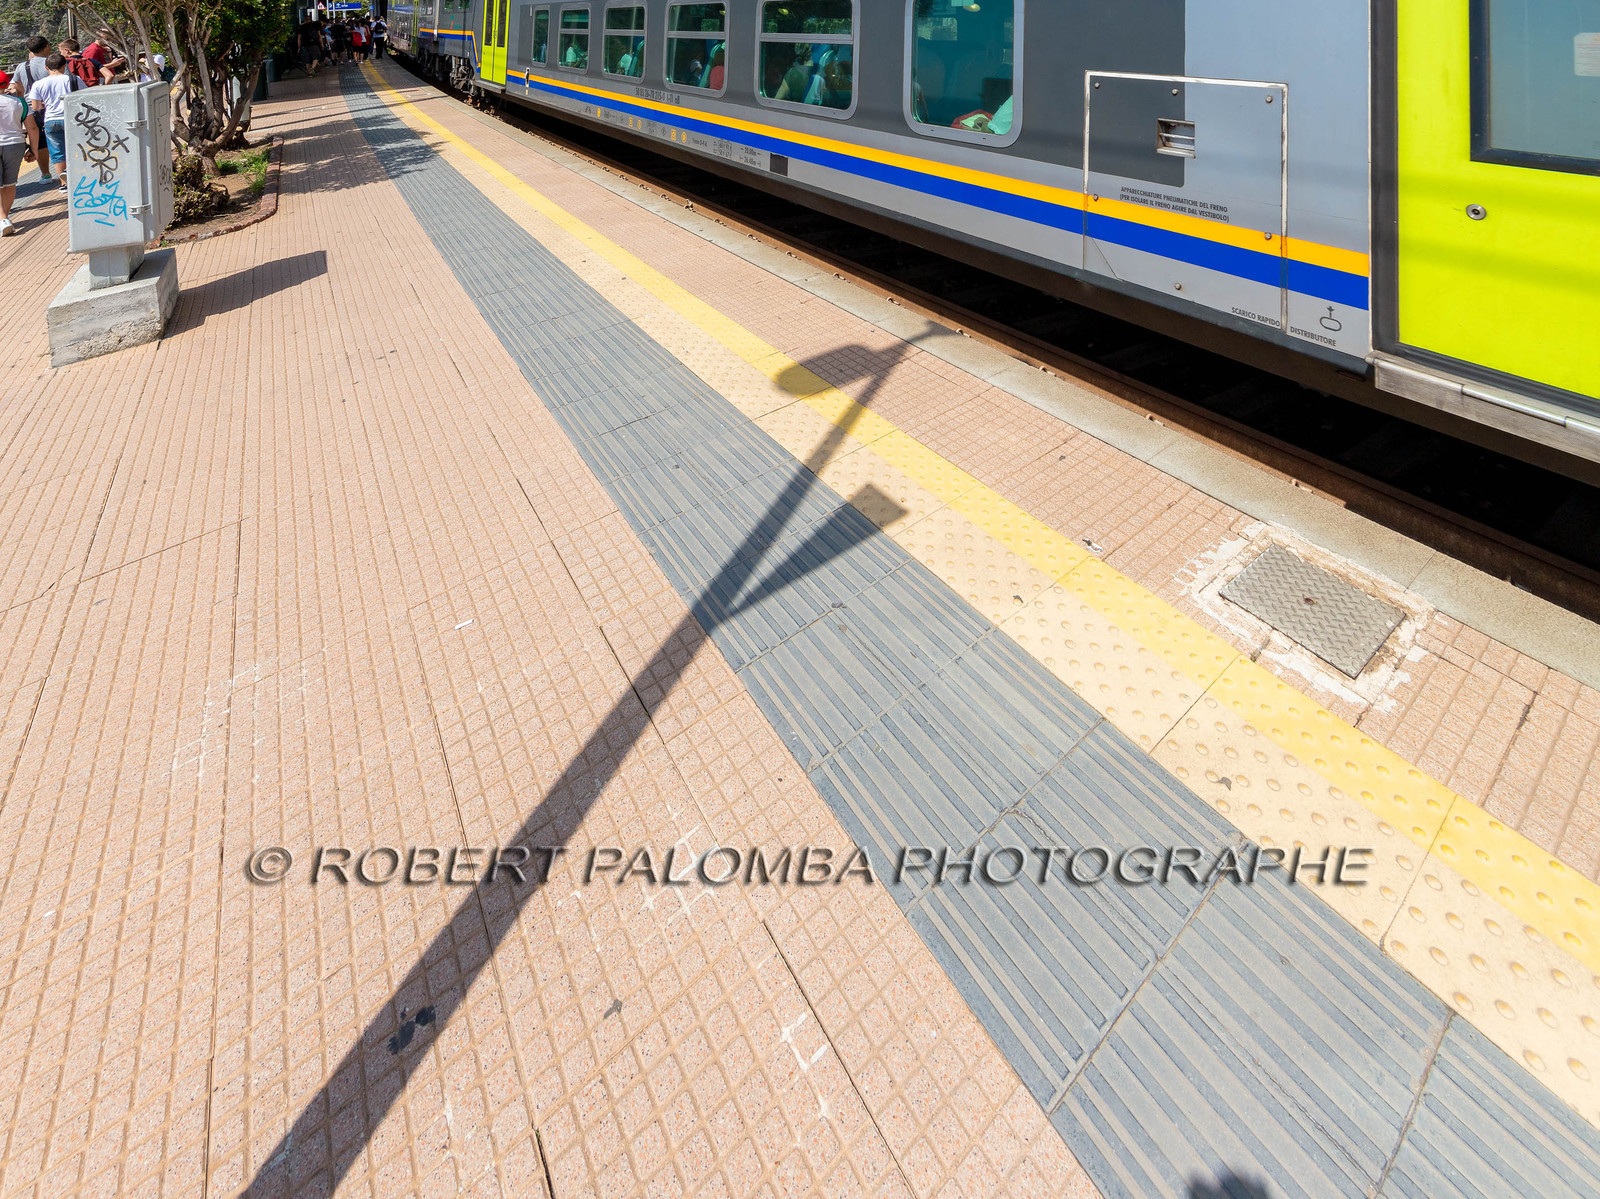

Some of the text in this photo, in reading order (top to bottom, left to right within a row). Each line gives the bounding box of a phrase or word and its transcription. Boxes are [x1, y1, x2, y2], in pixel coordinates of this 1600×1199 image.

[1119, 193, 1130, 201] (PER
[1130, 195, 1149, 205] ISOLARE
[1155, 201, 1171, 210] FRENO
[1171, 205, 1187, 213] AGIRE
[1198, 209, 1230, 223] VESTIBOLO)
[1120, 186, 1228, 213] APPARECCHIATURE PNEUMATICHE DEL FRENO
[1231, 306, 1337, 347] SCARICO RAPIDO DISTRIBUTORE
